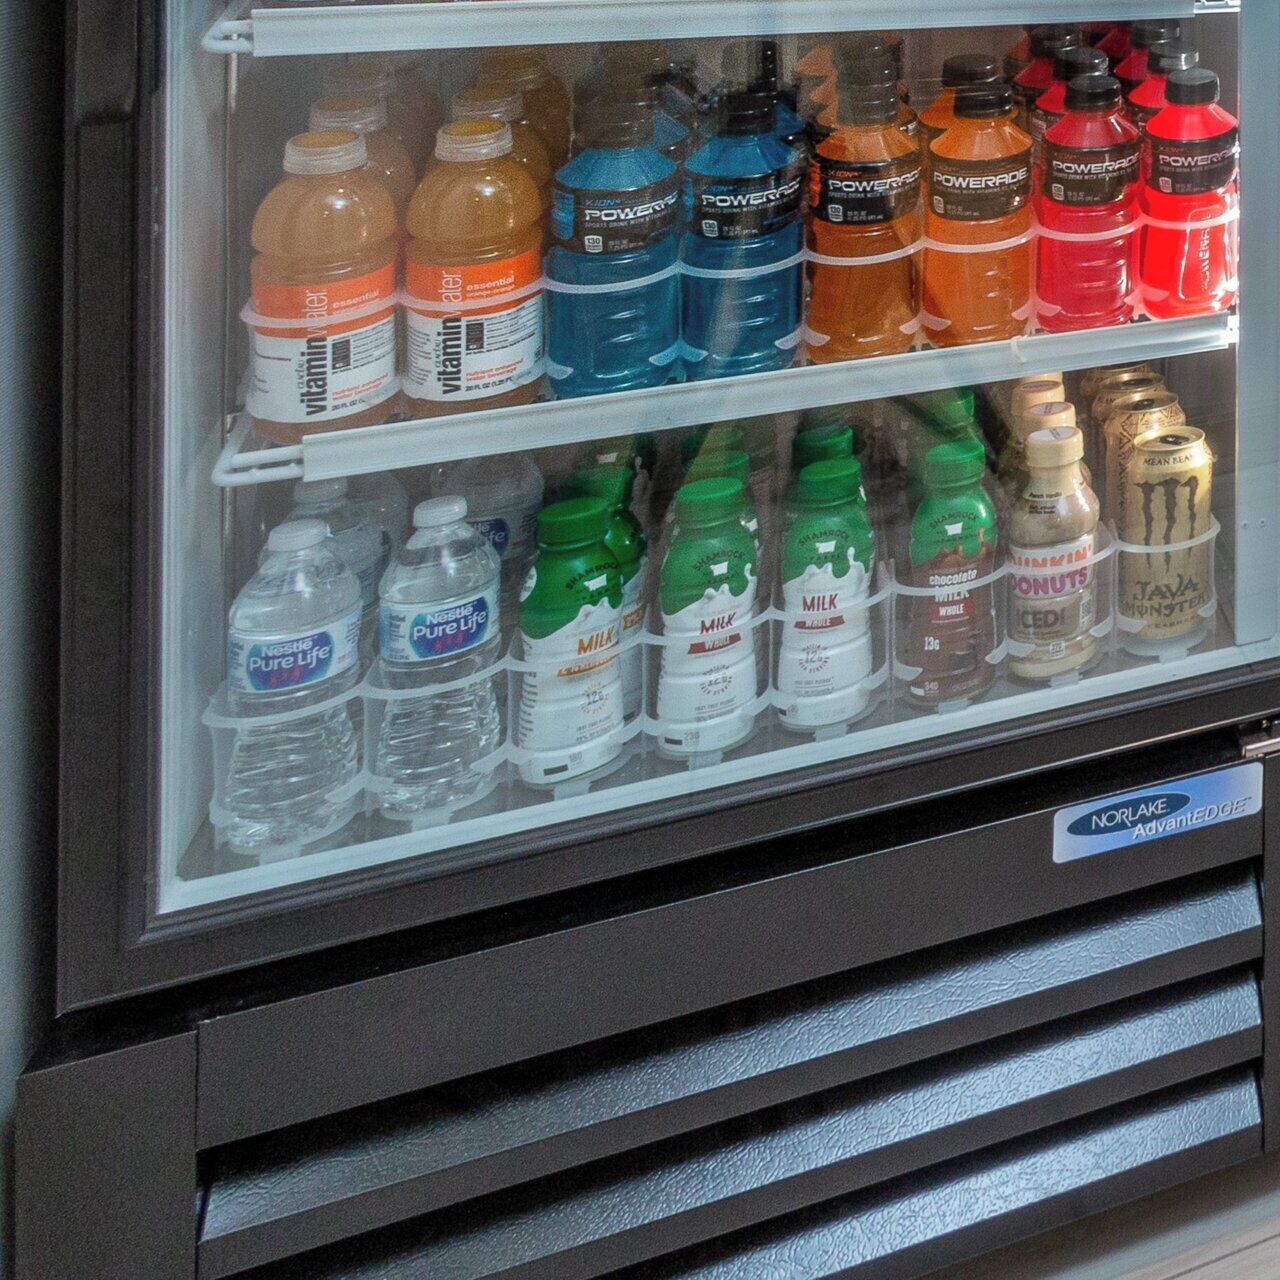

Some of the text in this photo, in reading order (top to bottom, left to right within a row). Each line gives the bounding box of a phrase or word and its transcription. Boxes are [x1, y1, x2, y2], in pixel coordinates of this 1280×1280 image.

[933, 167, 1028, 189] POWERADE
[465, 275, 515, 291] essential
[332, 288, 381, 309] essential
[1142, 456, 1169, 468] MEAN
[799, 529, 849, 544] SHAMROCK
[929, 569, 977, 586] chocolate
[1134, 574, 1200, 602] JAVA
[801, 594, 838, 612] MILK
[938, 604, 964, 616] WHOLE
[413, 608, 488, 642] Pure Life
[700, 613, 737, 634] MILK
[577, 627, 614, 655] MILK
[249, 644, 331, 672] Pure Life
[1091, 798, 1168, 830] NORLAKE
[1131, 798, 1247, 840] AdvantEDGE
